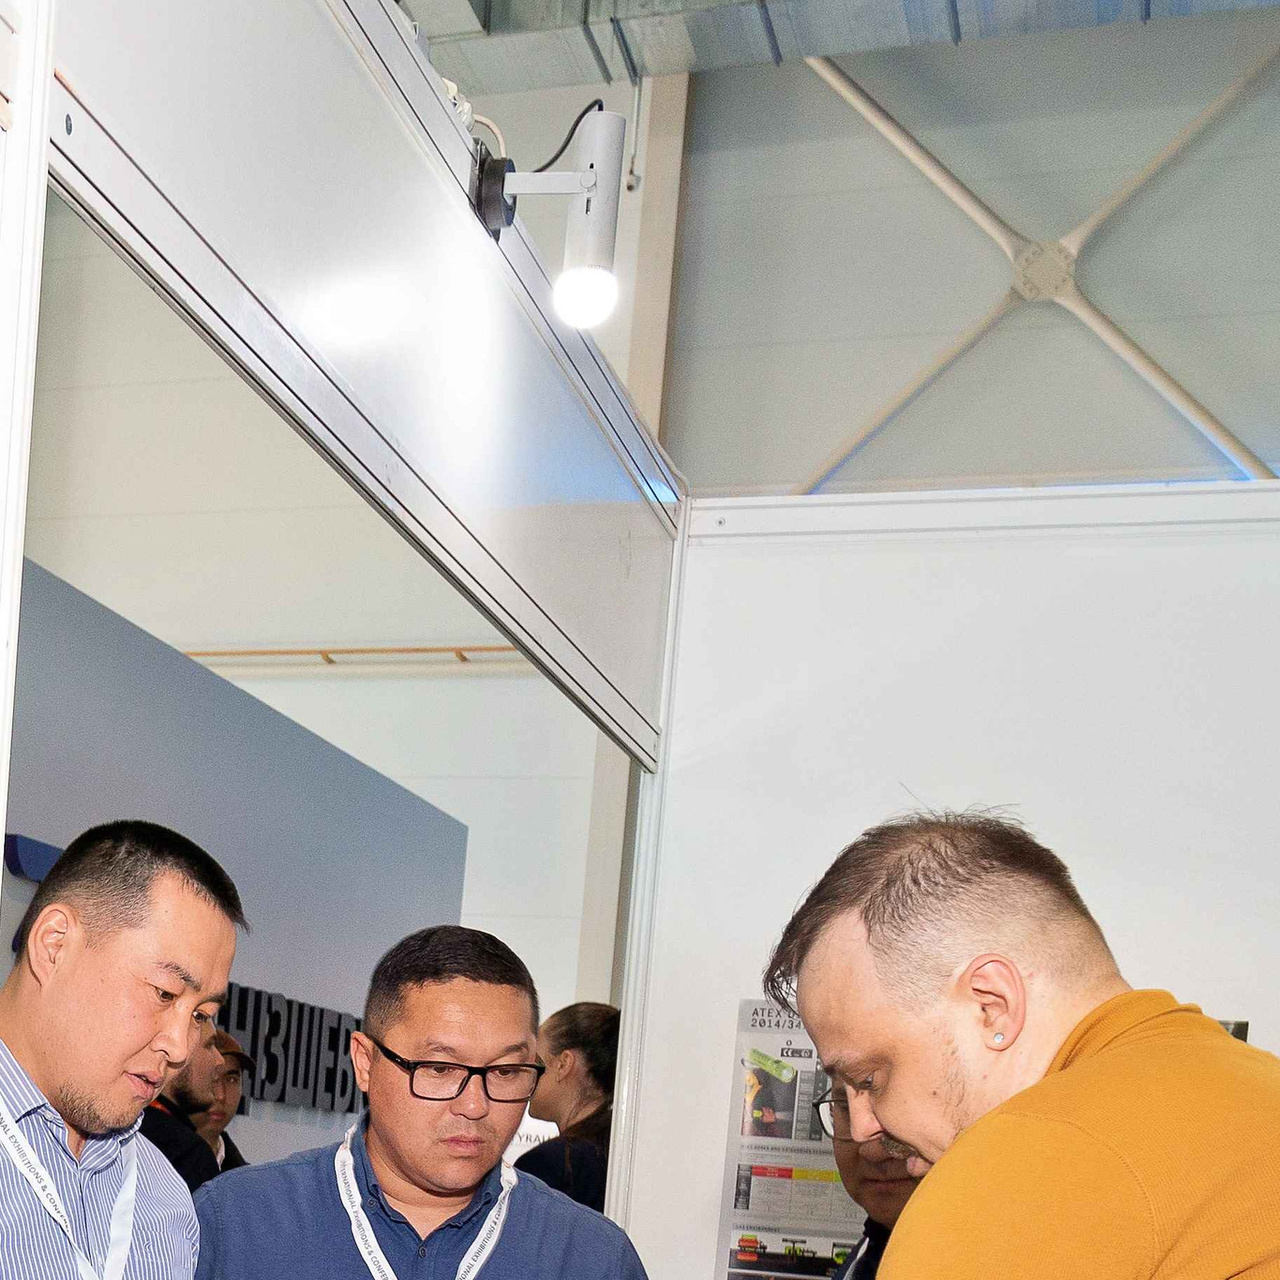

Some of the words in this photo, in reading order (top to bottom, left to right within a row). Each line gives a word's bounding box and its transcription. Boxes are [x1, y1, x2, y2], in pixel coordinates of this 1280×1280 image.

[751, 1007, 783, 1019] ATEX
[9, 1133, 45, 1184] EXHIBITIONS
[471, 1225, 496, 1263] EXHIBITIONS
